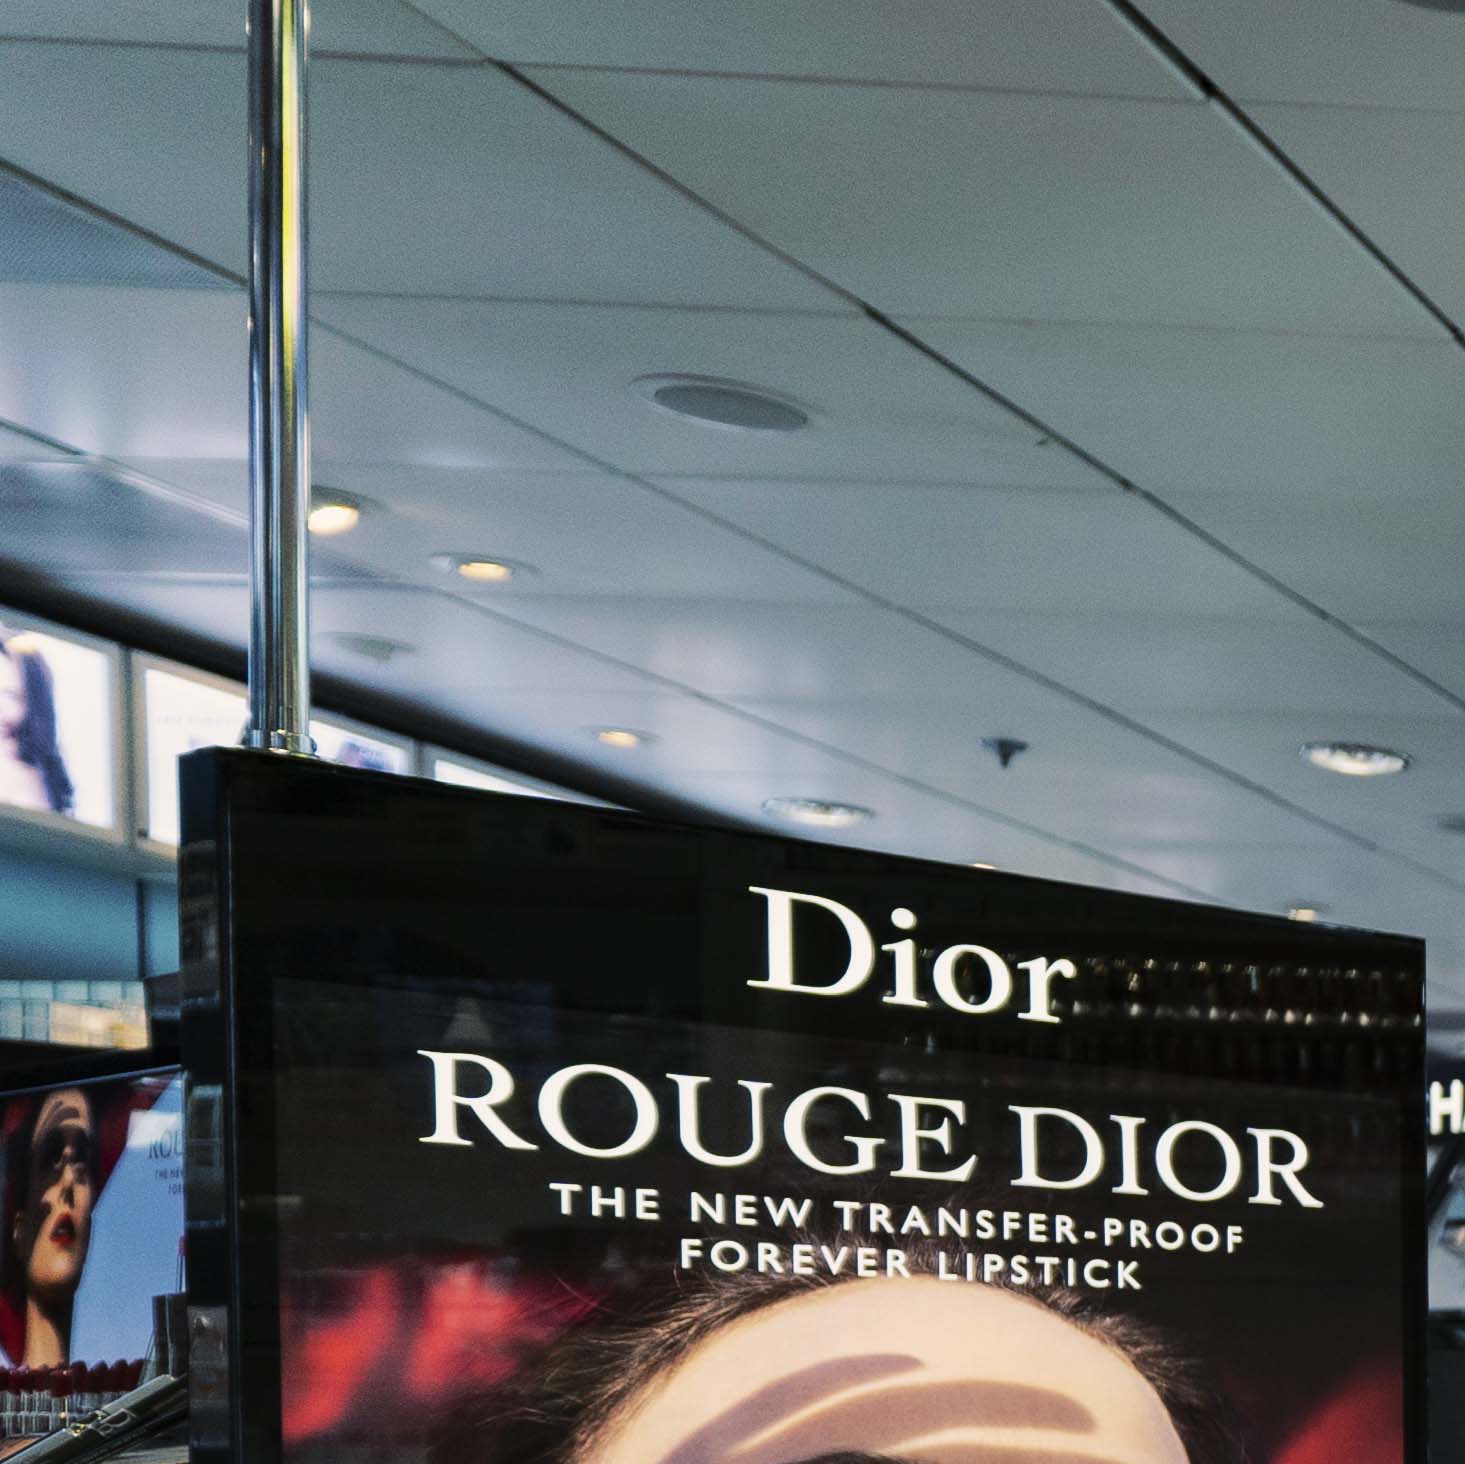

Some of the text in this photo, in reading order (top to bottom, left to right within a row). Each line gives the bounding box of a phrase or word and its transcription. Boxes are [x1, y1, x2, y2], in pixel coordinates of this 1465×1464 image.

[746, 885, 1076, 1023] Dior
[417, 1049, 1324, 1209] ROUGE DIOR
[548, 1182, 1244, 1255] THE NEW TRANSFER-PROOF
[680, 1238, 1142, 1291] FOREVER LIPSTICK
